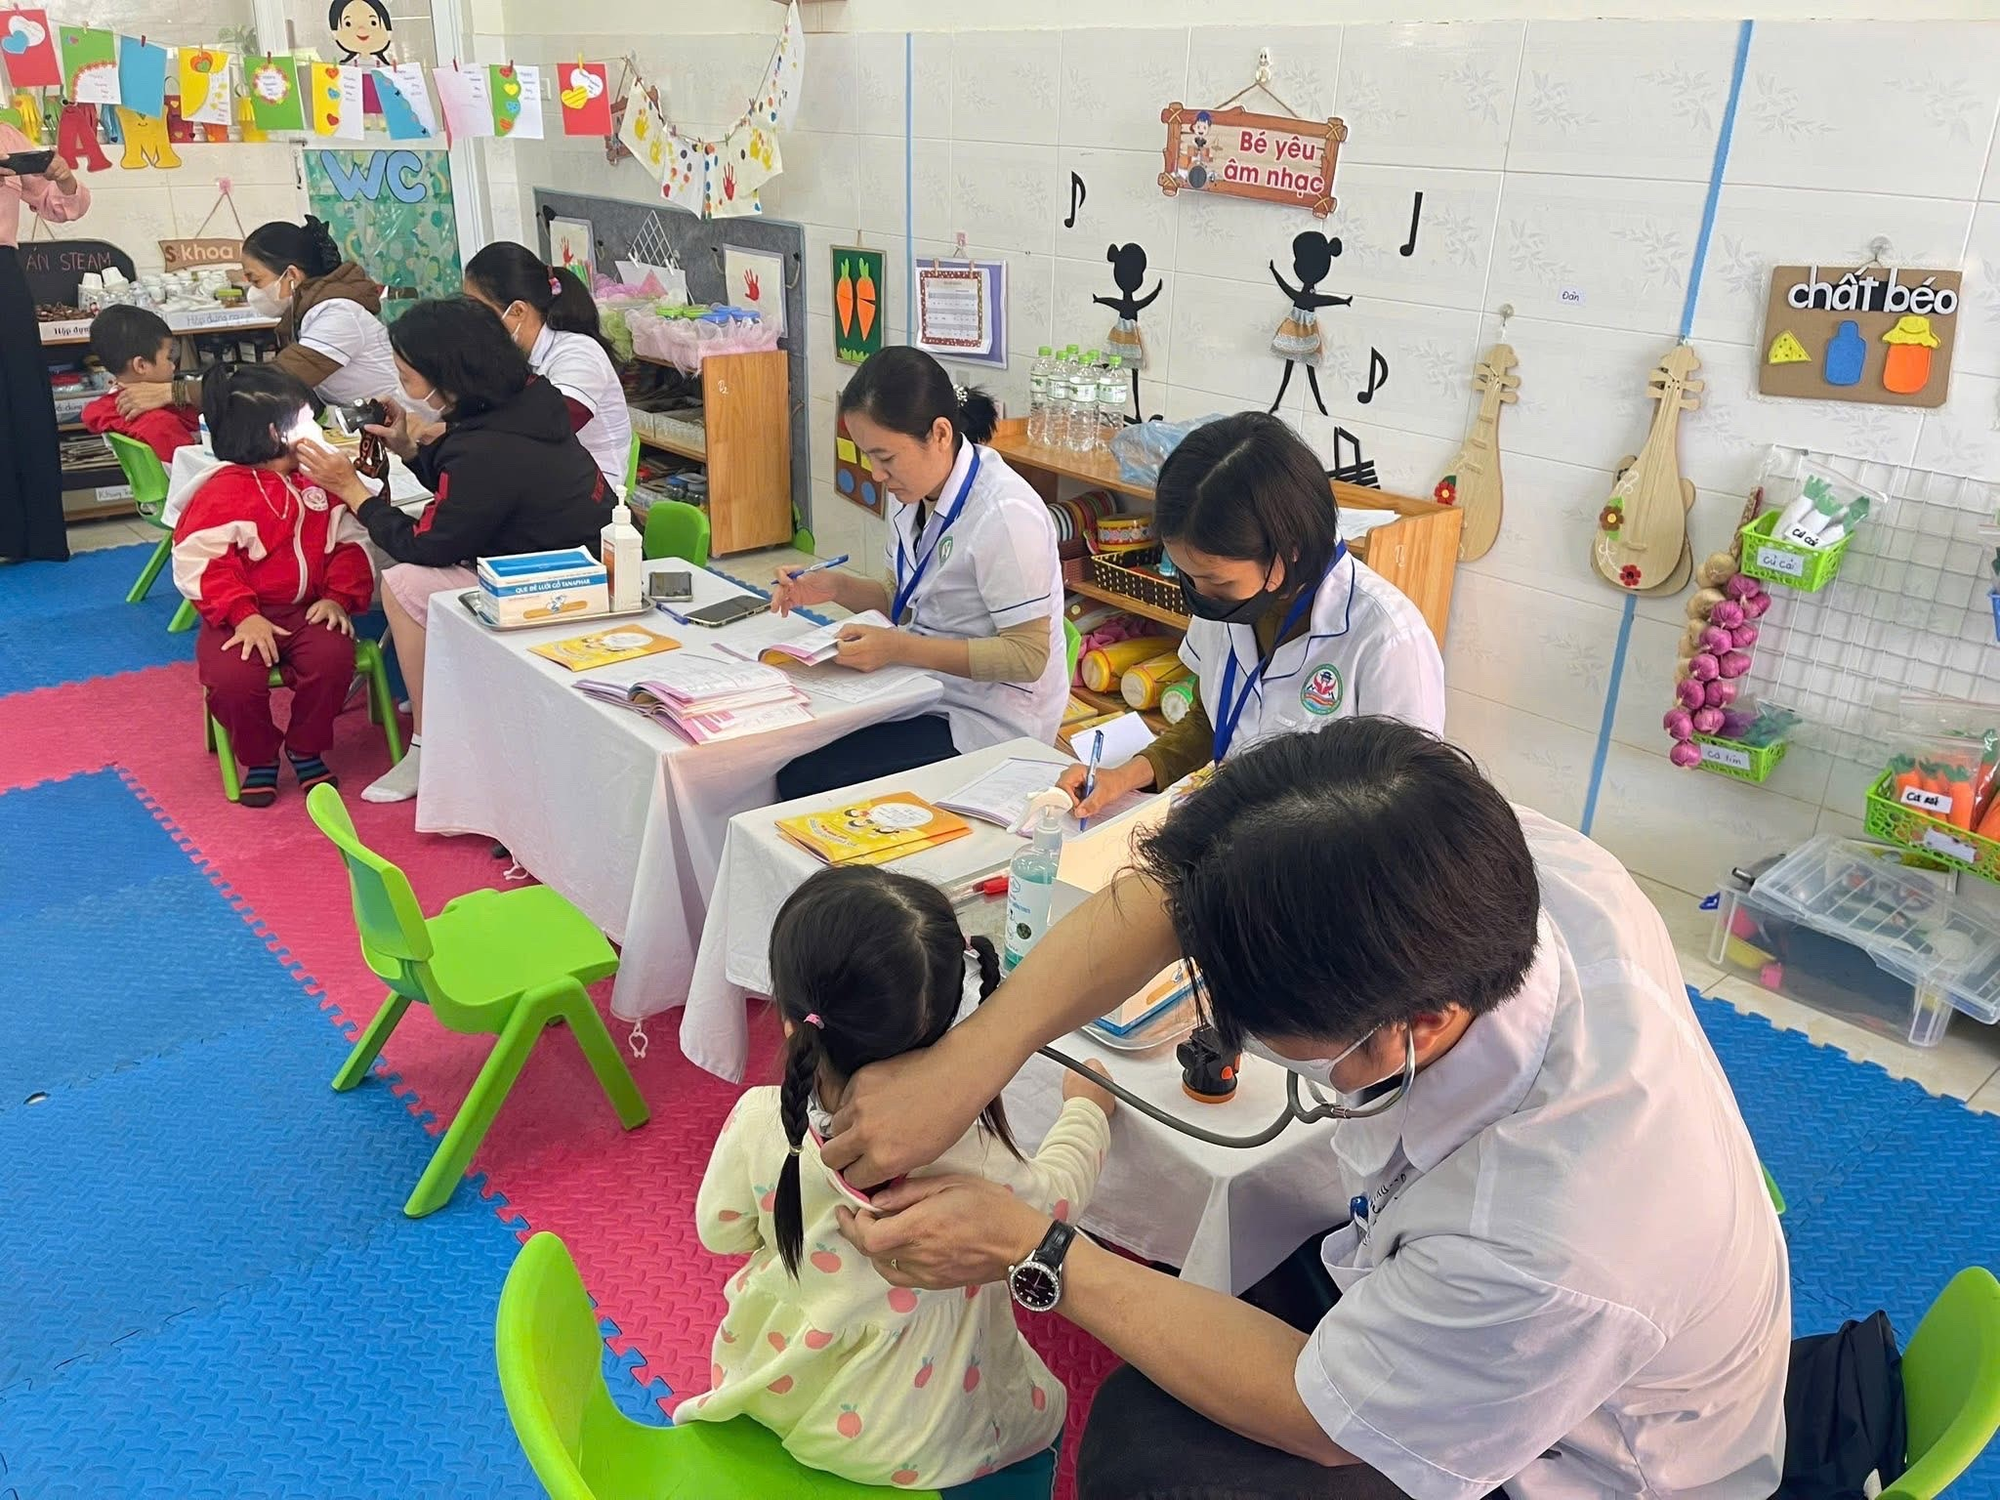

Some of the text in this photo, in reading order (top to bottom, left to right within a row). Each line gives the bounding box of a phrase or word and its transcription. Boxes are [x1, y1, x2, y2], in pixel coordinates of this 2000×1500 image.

[1239, 131, 1316, 161] Bé yêu
[320, 149, 427, 204] WC
[1223, 158, 1325, 198] âm nhạc
[60, 251, 112, 271] STEAM
[180, 243, 234, 261] khoa
[1787, 265, 1959, 315] chất béo
